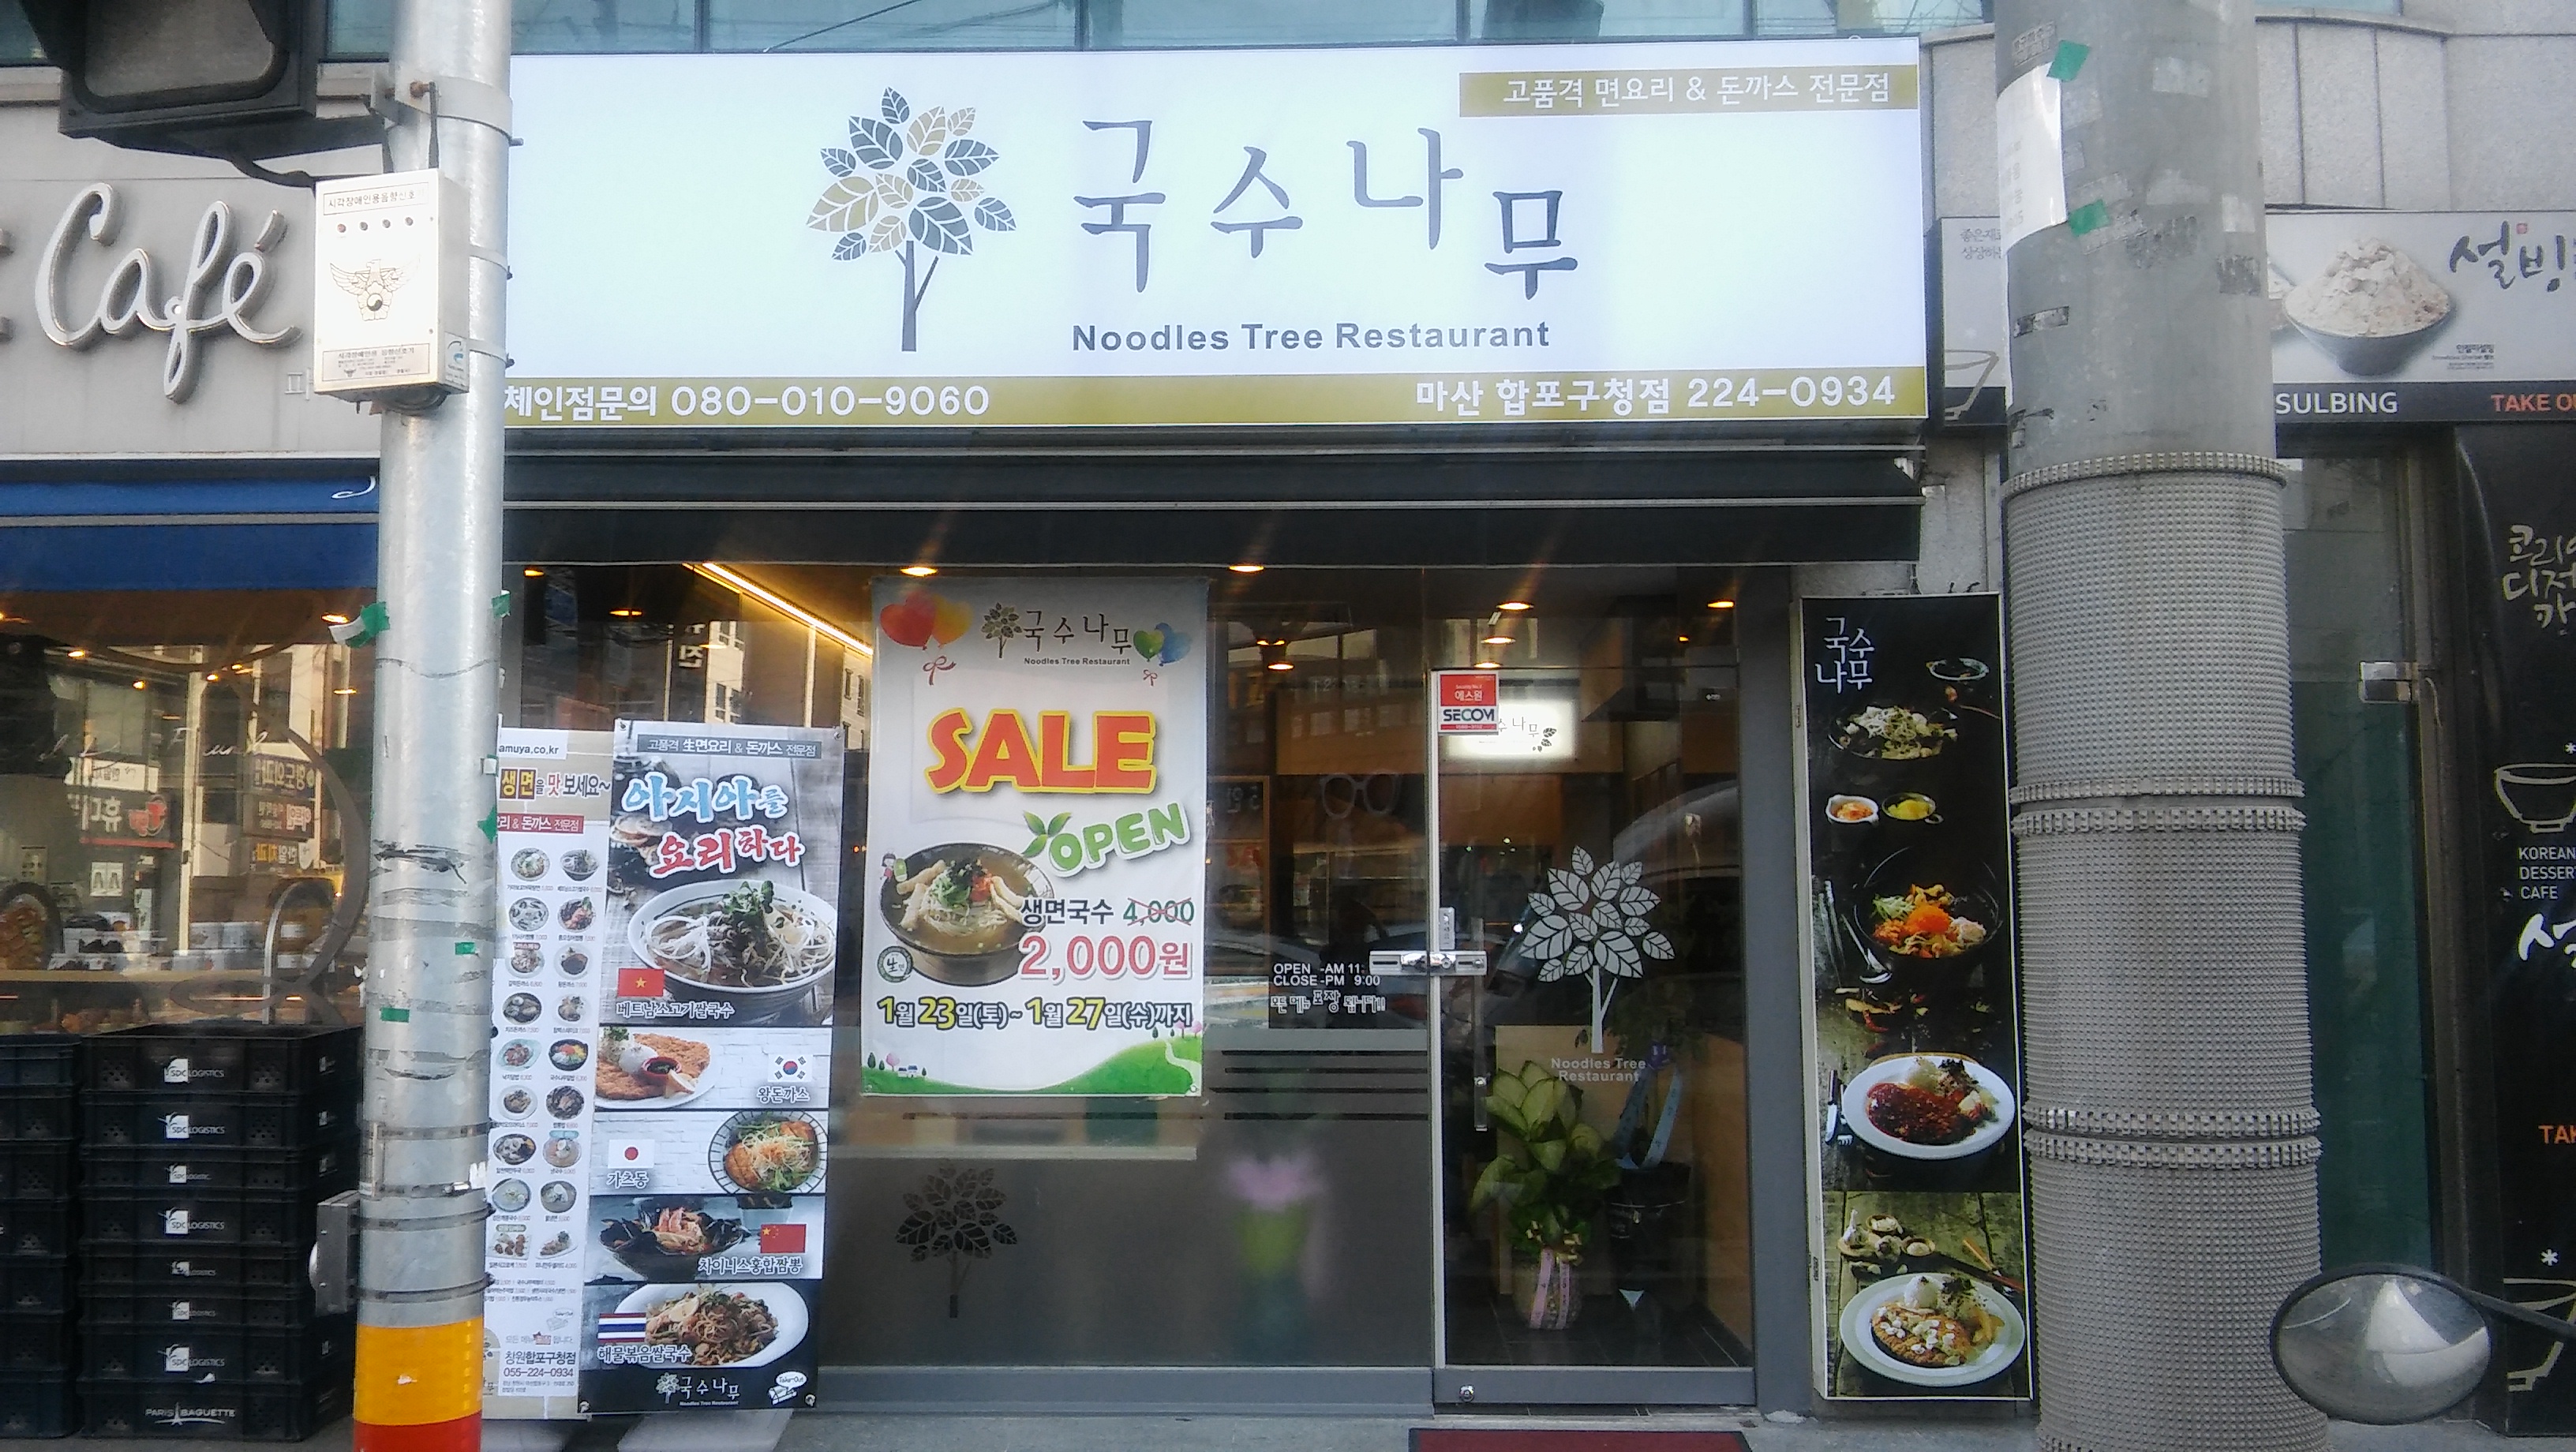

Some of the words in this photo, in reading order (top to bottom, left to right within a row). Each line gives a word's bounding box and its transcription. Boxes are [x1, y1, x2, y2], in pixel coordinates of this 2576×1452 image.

[1503, 78, 1583, 108] 고품격
[1594, 77, 1674, 107] 면요리
[1686, 79, 1705, 101] &
[1717, 75, 1799, 106] 돈까스
[1809, 73, 1890, 103] 전문점
[1073, 119, 1578, 301] 국수나무
[1960, 228, 2001, 242] 좋은재
[1961, 246, 2001, 260] 상상하
[2449, 220, 2565, 292] 설빙
[35, 182, 302, 403] Café
[1073, 324, 1229, 352] Noodles
[1241, 323, 1324, 351] Tree
[1335, 321, 1549, 349] Restaurant
[504, 385, 657, 421] 체인점문의
[671, 385, 990, 417] 080-010-9060
[1417, 380, 1485, 417] 마산
[1496, 378, 1671, 415] 합포구청점
[1687, 375, 1896, 409] 224-0934
[2275, 391, 2398, 414] SULBING
[2491, 394, 2551, 412] TAKE
[1024, 610, 1132, 655] 국수나무
[1823, 616, 1874, 664] 국수
[1814, 660, 1874, 694] 나무
[1455, 690, 1483, 702] 에스원
[1443, 708, 1495, 722] SECOM
[647, 739, 679, 750] 고품격
[735, 743, 743, 753] &
[746, 740, 783, 755] 돈까스
[785, 744, 816, 758] 전문점
[924, 707, 1159, 794] SALE
[548, 774, 561, 796] 맛
[623, 773, 788, 819] 아시아를
[512, 819, 519, 829] &
[522, 816, 552, 831] 돈까스
[554, 819, 579, 832] 전문점
[1048, 802, 1190, 875] OPEN
[650, 826, 804, 877] 요리하다
[2518, 846, 2576, 860] KOREAN
[2519, 866, 2576, 880] DESSER
[2520, 885, 2559, 900] CAFE
[1021, 899, 1114, 926] 생면국수
[1123, 898, 1195, 926] 4,000
[1021, 934, 1192, 982] 2,000원
[1273, 963, 1311, 975] OPEN
[1273, 975, 1317, 986] CLOSE
[1354, 975, 1380, 986] 9:00
[616, 1001, 736, 1020] 베트남소고기쌀국수
[1271, 995, 1287, 1014] 모든
[1289, 995, 1311, 1014] 메뉴
[1312, 989, 1341, 1013] 포장
[877, 997, 916, 1027] 1월
[1024, 997, 1065, 1027] 1월
[1551, 1057, 1610, 1069] Noodles
[1615, 1057, 1646, 1069] Tree
[189, 1069, 225, 1078] LOGISTICS
[1559, 1069, 1639, 1082] Restaurant
[756, 1086, 811, 1104] 왕돈까스
[189, 1126, 226, 1135] LOGISTICS
[606, 1171, 648, 1188] 가츠동
[188, 1221, 225, 1230] LOGISTICS
[697, 1256, 803, 1275] 차이니스홍합짬뽕
[189, 1358, 225, 1368] LOGISTICS
[504, 1350, 576, 1365] 창원합포구청점
[596, 1345, 692, 1364] 해물볶음쌀국수
[504, 1368, 574, 1377] 055-224-0934
[680, 1375, 740, 1400] 국수나무
[145, 1408, 174, 1417] PARIS
[180, 1408, 235, 1417] BAGUETTE
